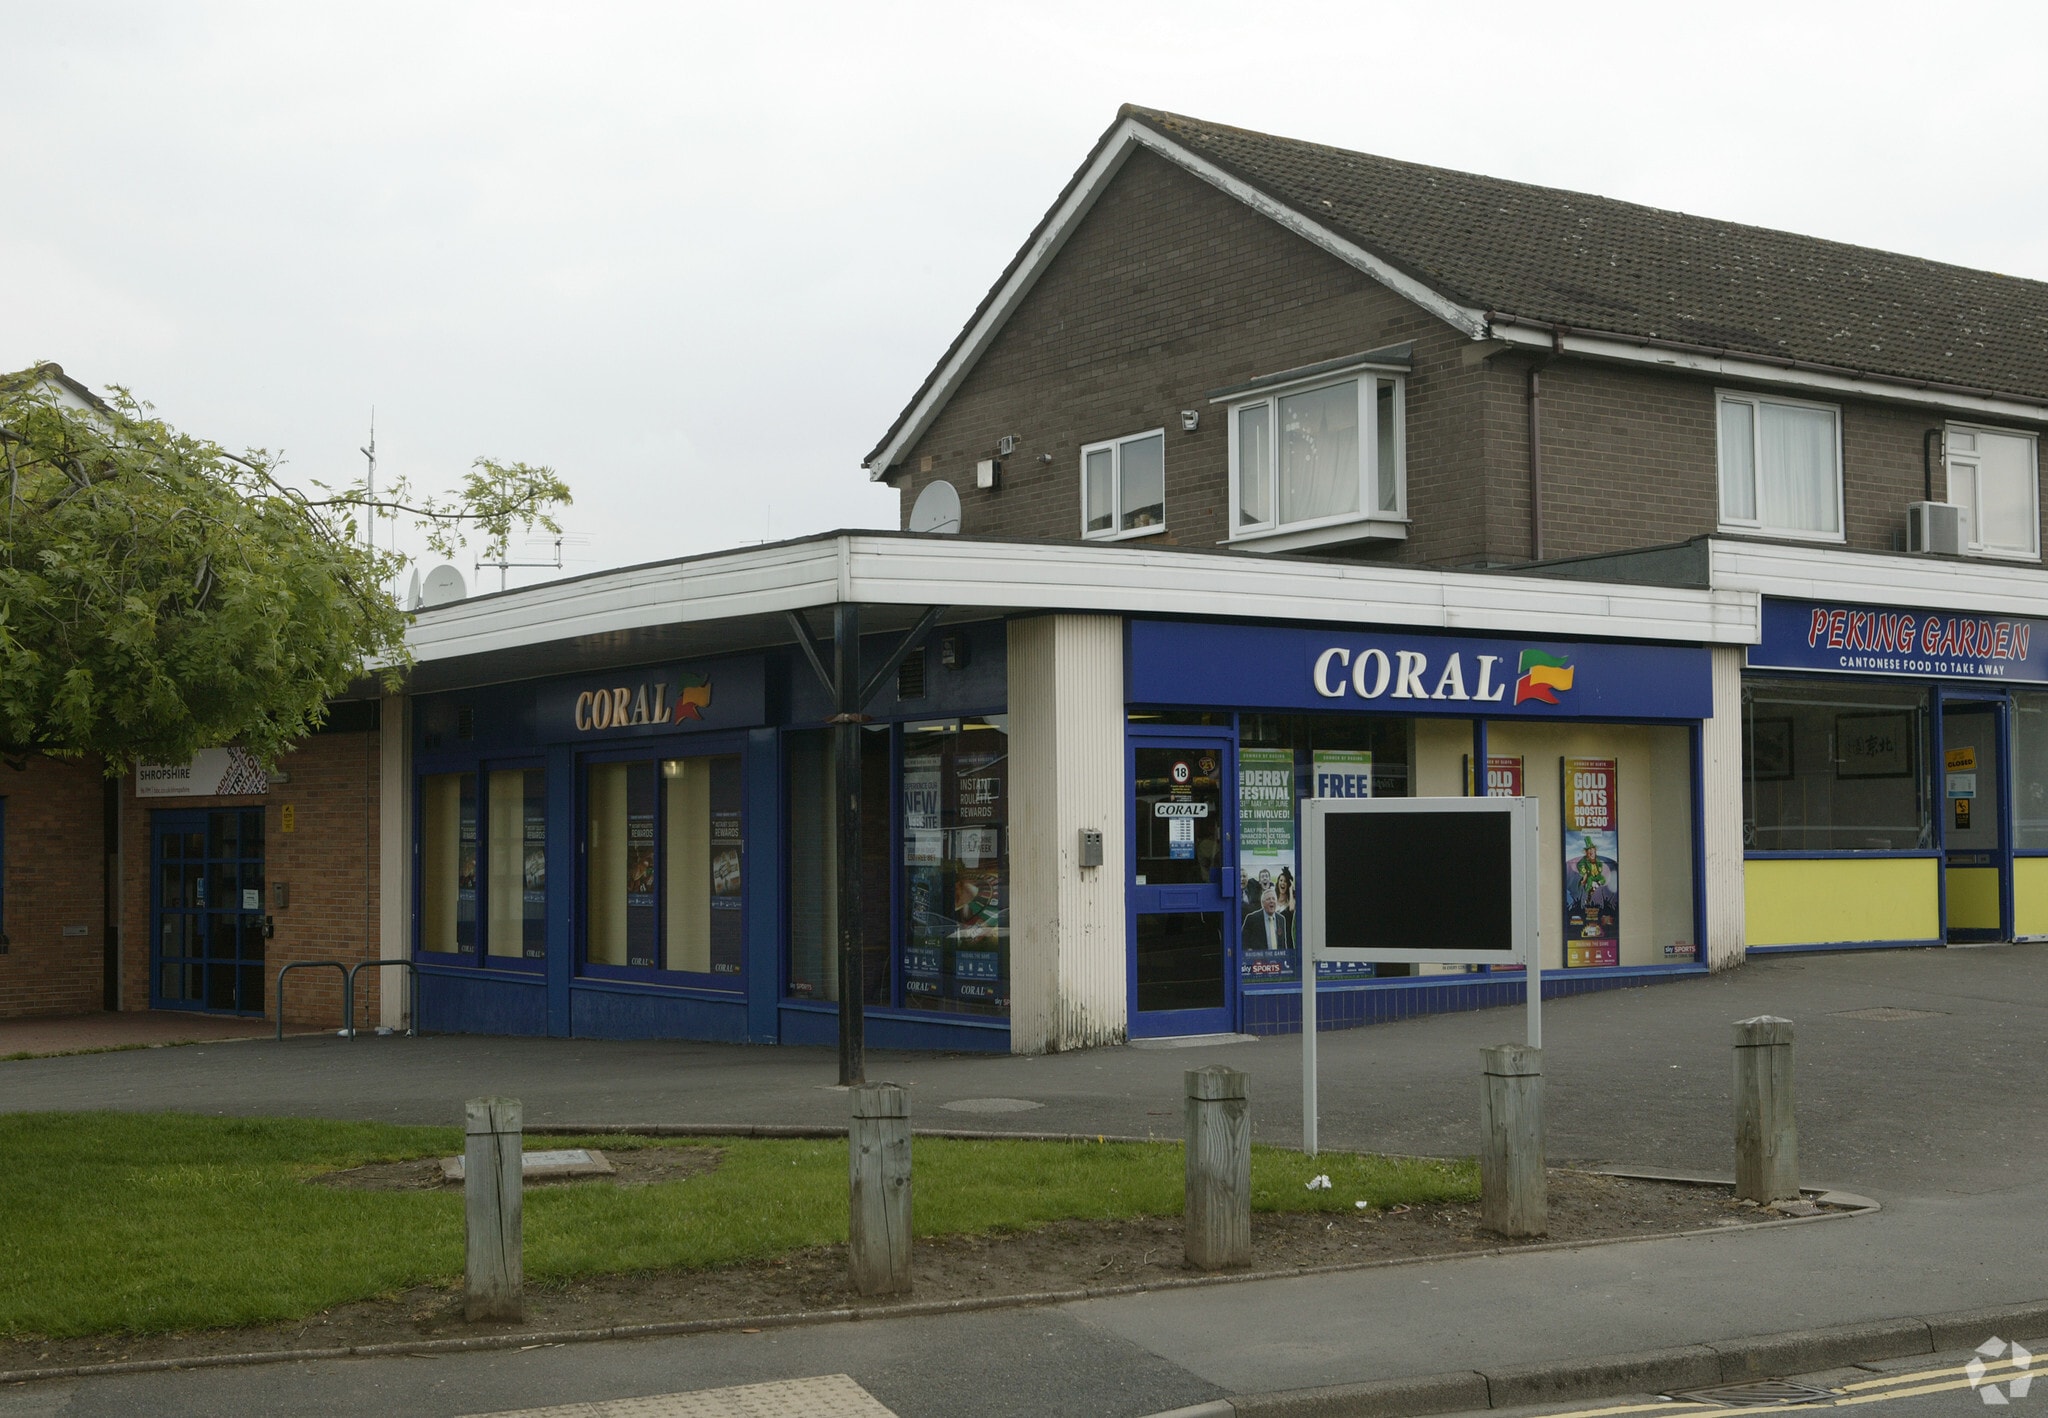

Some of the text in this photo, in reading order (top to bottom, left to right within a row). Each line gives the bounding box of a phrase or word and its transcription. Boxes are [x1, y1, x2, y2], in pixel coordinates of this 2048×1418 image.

[1808, 608, 2030, 661] PEKING GARDEN
[1840, 656, 2005, 676] CANTONESE FOOD TO TAKE AWAY
[1313, 647, 1505, 701] CORAL
[575, 682, 671, 731] CORAL
[1947, 759, 1973, 768] CLOSED
[140, 768, 191, 781] SHROPSHIRE
[1175, 768, 1187, 779] 18
[1245, 770, 1290, 786] DERBY
[1487, 771, 1513, 787] OLD
[960, 778, 991, 791] INSTANT
[1318, 774, 1368, 798] FREE
[1574, 772, 1607, 789] GOLD
[1239, 787, 1290, 800] FESTIVAL
[1574, 790, 1607, 806] POTS
[905, 790, 938, 815] NEW
[960, 806, 992, 818] REWARDS
[1157, 804, 1199, 815] CORAL
[1240, 810, 1290, 819] GET INVOLVED!
[1574, 806, 1607, 816] BOOSTED
[1575, 816, 1585, 827] TO
[631, 829, 653, 838] REWARDS
[715, 828, 739, 838] REWARDS
[526, 949, 541, 958] CORAL
[1664, 945, 1697, 954] sky SPORTS
[631, 957, 649, 966] CORAL
[715, 963, 734, 973] CORAL
[1252, 964, 1280, 973] SPORTS
[907, 981, 929, 992] CORAL
[961, 985, 986, 996] CORAL
